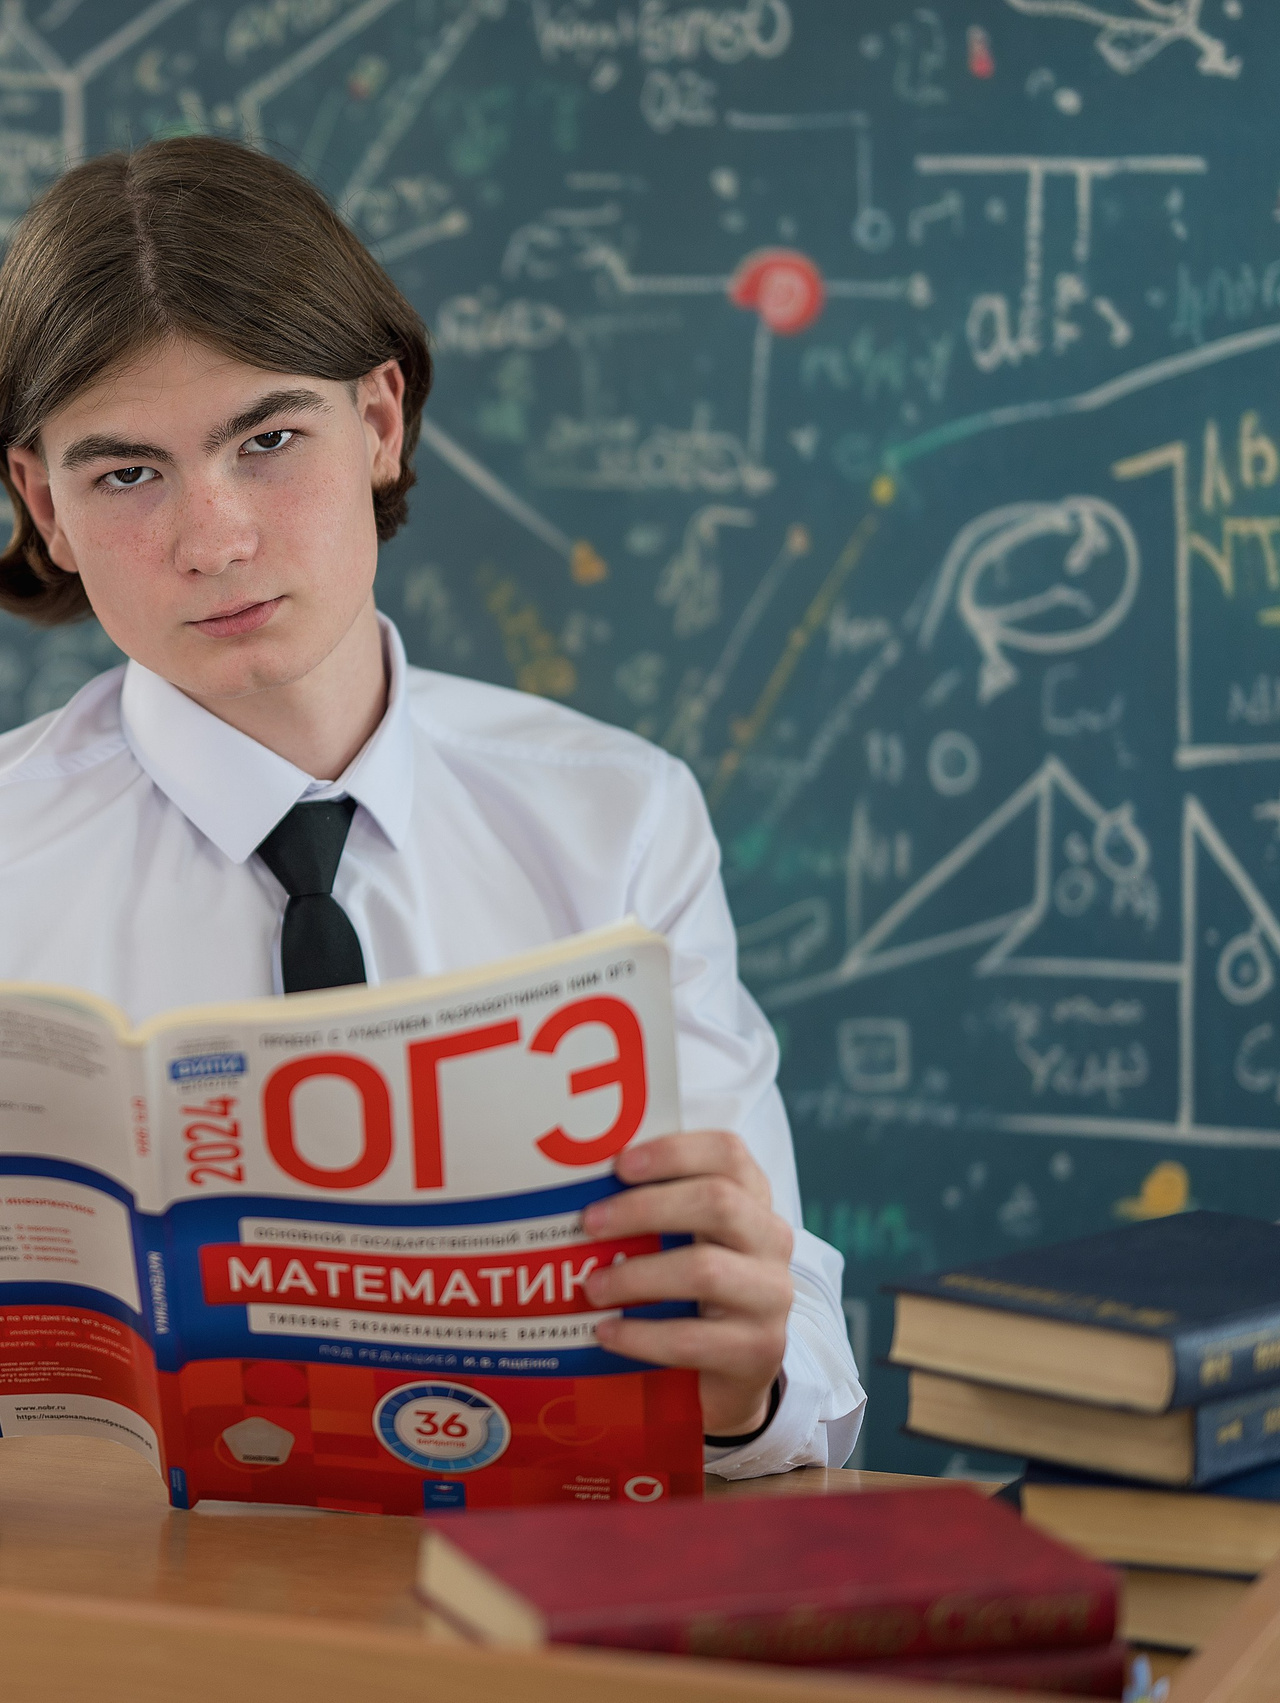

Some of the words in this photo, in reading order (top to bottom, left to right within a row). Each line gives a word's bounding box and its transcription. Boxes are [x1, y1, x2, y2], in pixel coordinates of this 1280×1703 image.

[261, 992, 649, 1192] ОГЭ
[179, 1095, 246, 1188] 2024
[524, 1224, 586, 1244] ЭКЗАМ
[226, 1251, 627, 1308] МАТЕМАТИК
[22, 1314, 81, 1324] ПРЕДМЕТАМ
[267, 1310, 342, 1333] ТИПОВЫЕ
[319, 1344, 354, 1360] ПОД
[358, 1346, 459, 1368] РЕДАКЦИЕЙ
[498, 1355, 561, 1371] ЯЩЕНКО
[14, 1404, 66, 1412] www.nobr.ru
[414, 1410, 468, 1438] 36
